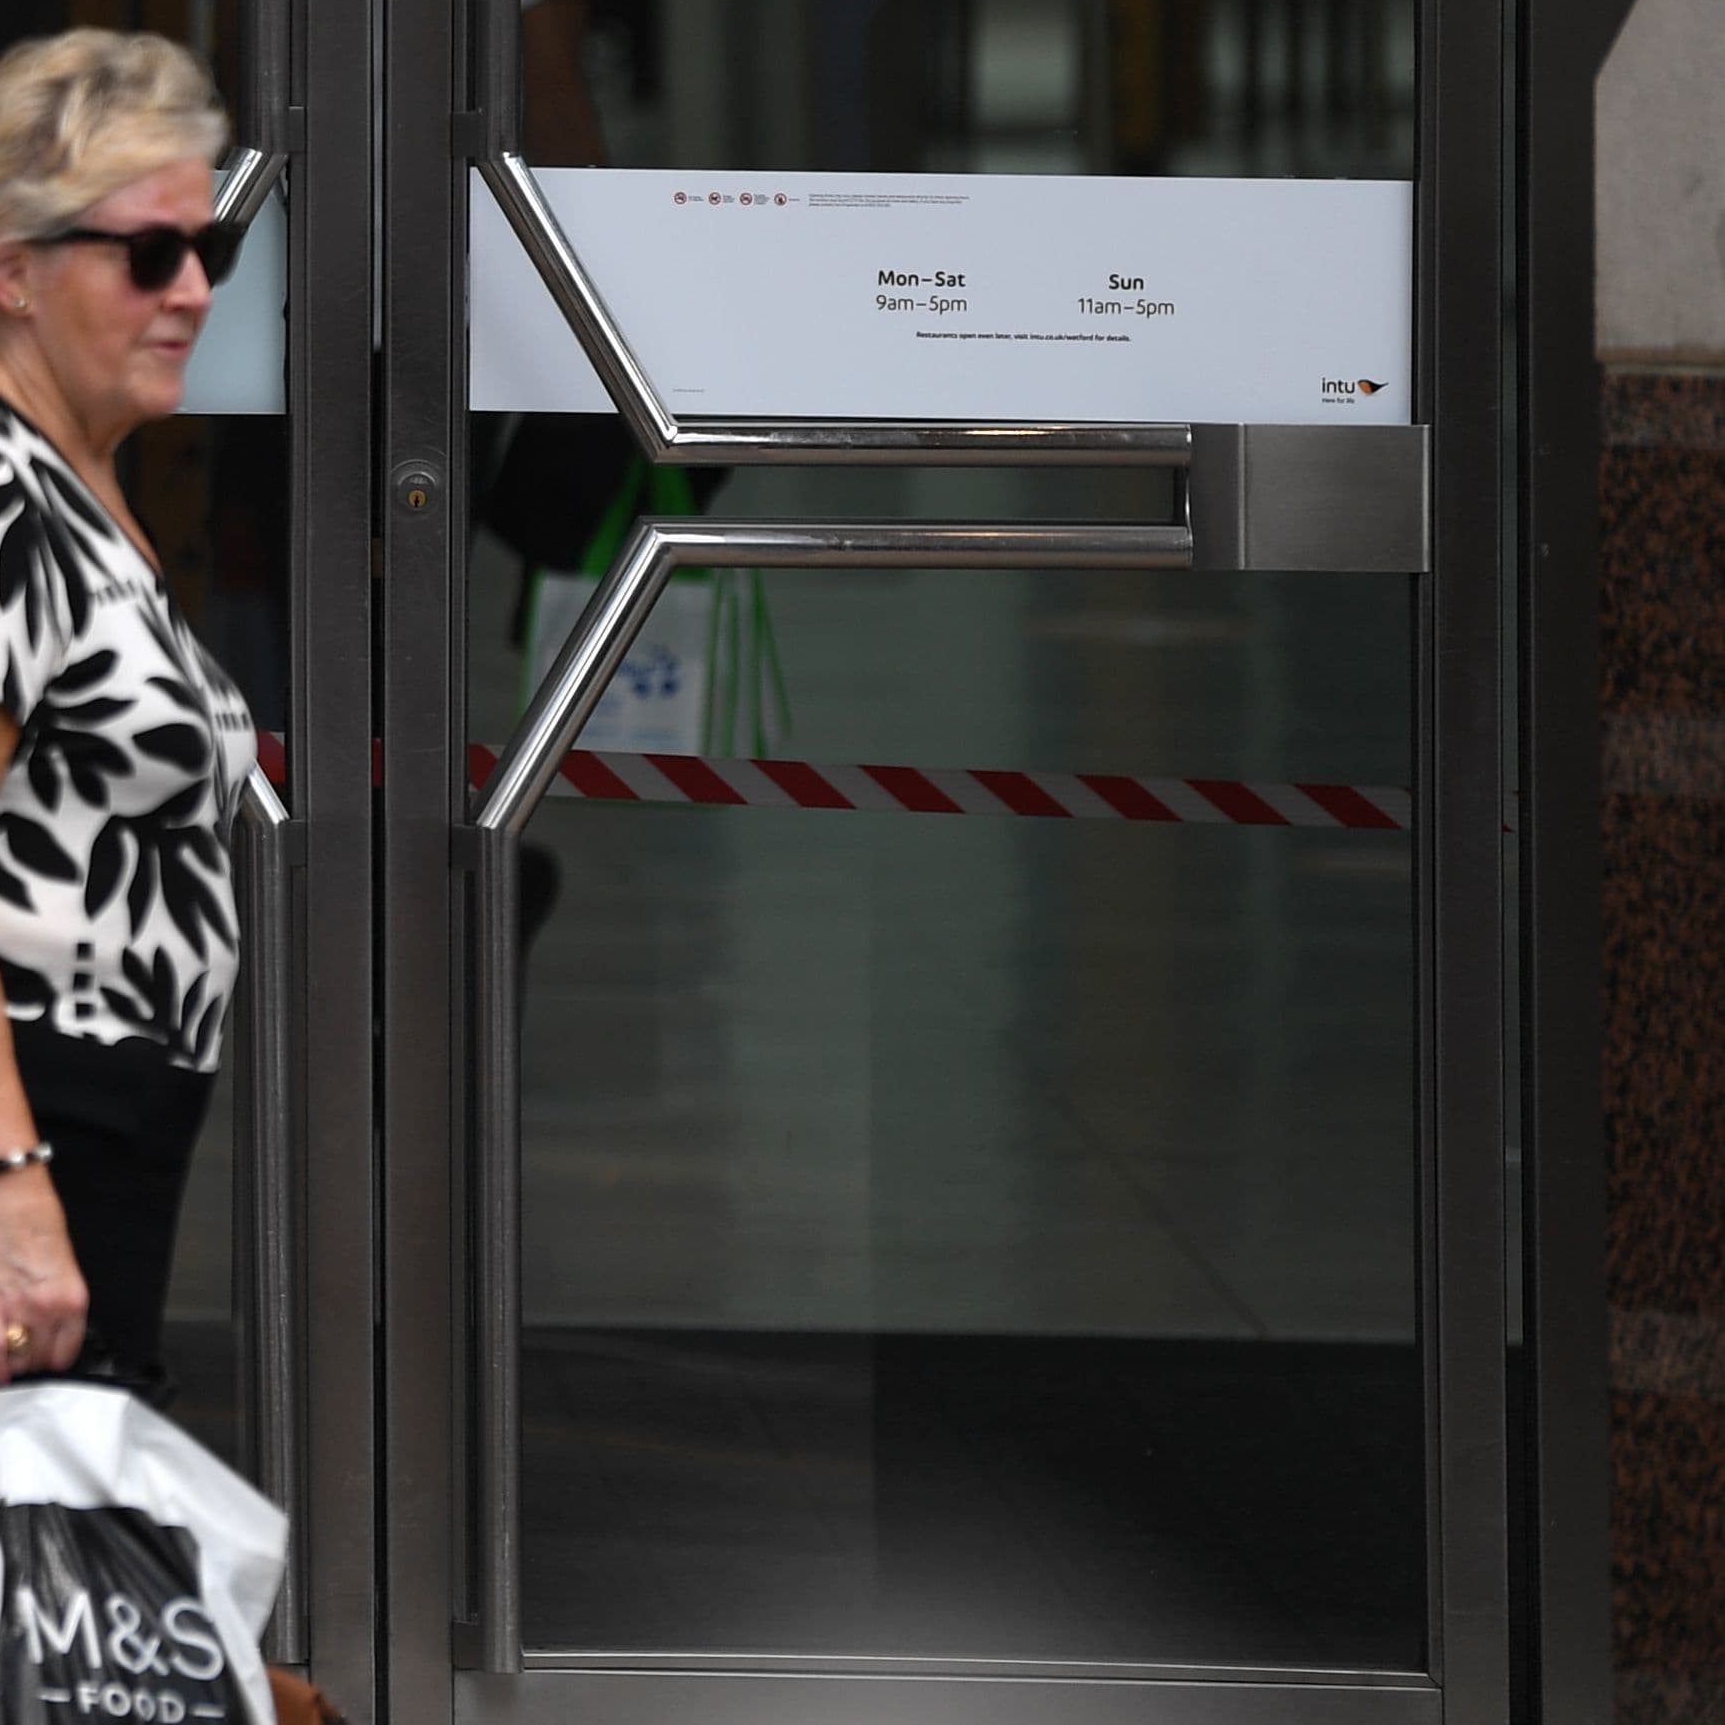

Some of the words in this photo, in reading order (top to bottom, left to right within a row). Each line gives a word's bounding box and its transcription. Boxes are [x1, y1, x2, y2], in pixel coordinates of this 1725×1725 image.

[1108, 273, 1145, 291] Sun
[916, 331, 958, 339] Restaurants
[959, 333, 977, 341] open
[1013, 333, 1029, 341] visit
[1094, 334, 1106, 342] for
[1321, 377, 1356, 395] intu
[17, 1587, 224, 1680] M&S
[76, 1681, 186, 1724] FOOD
